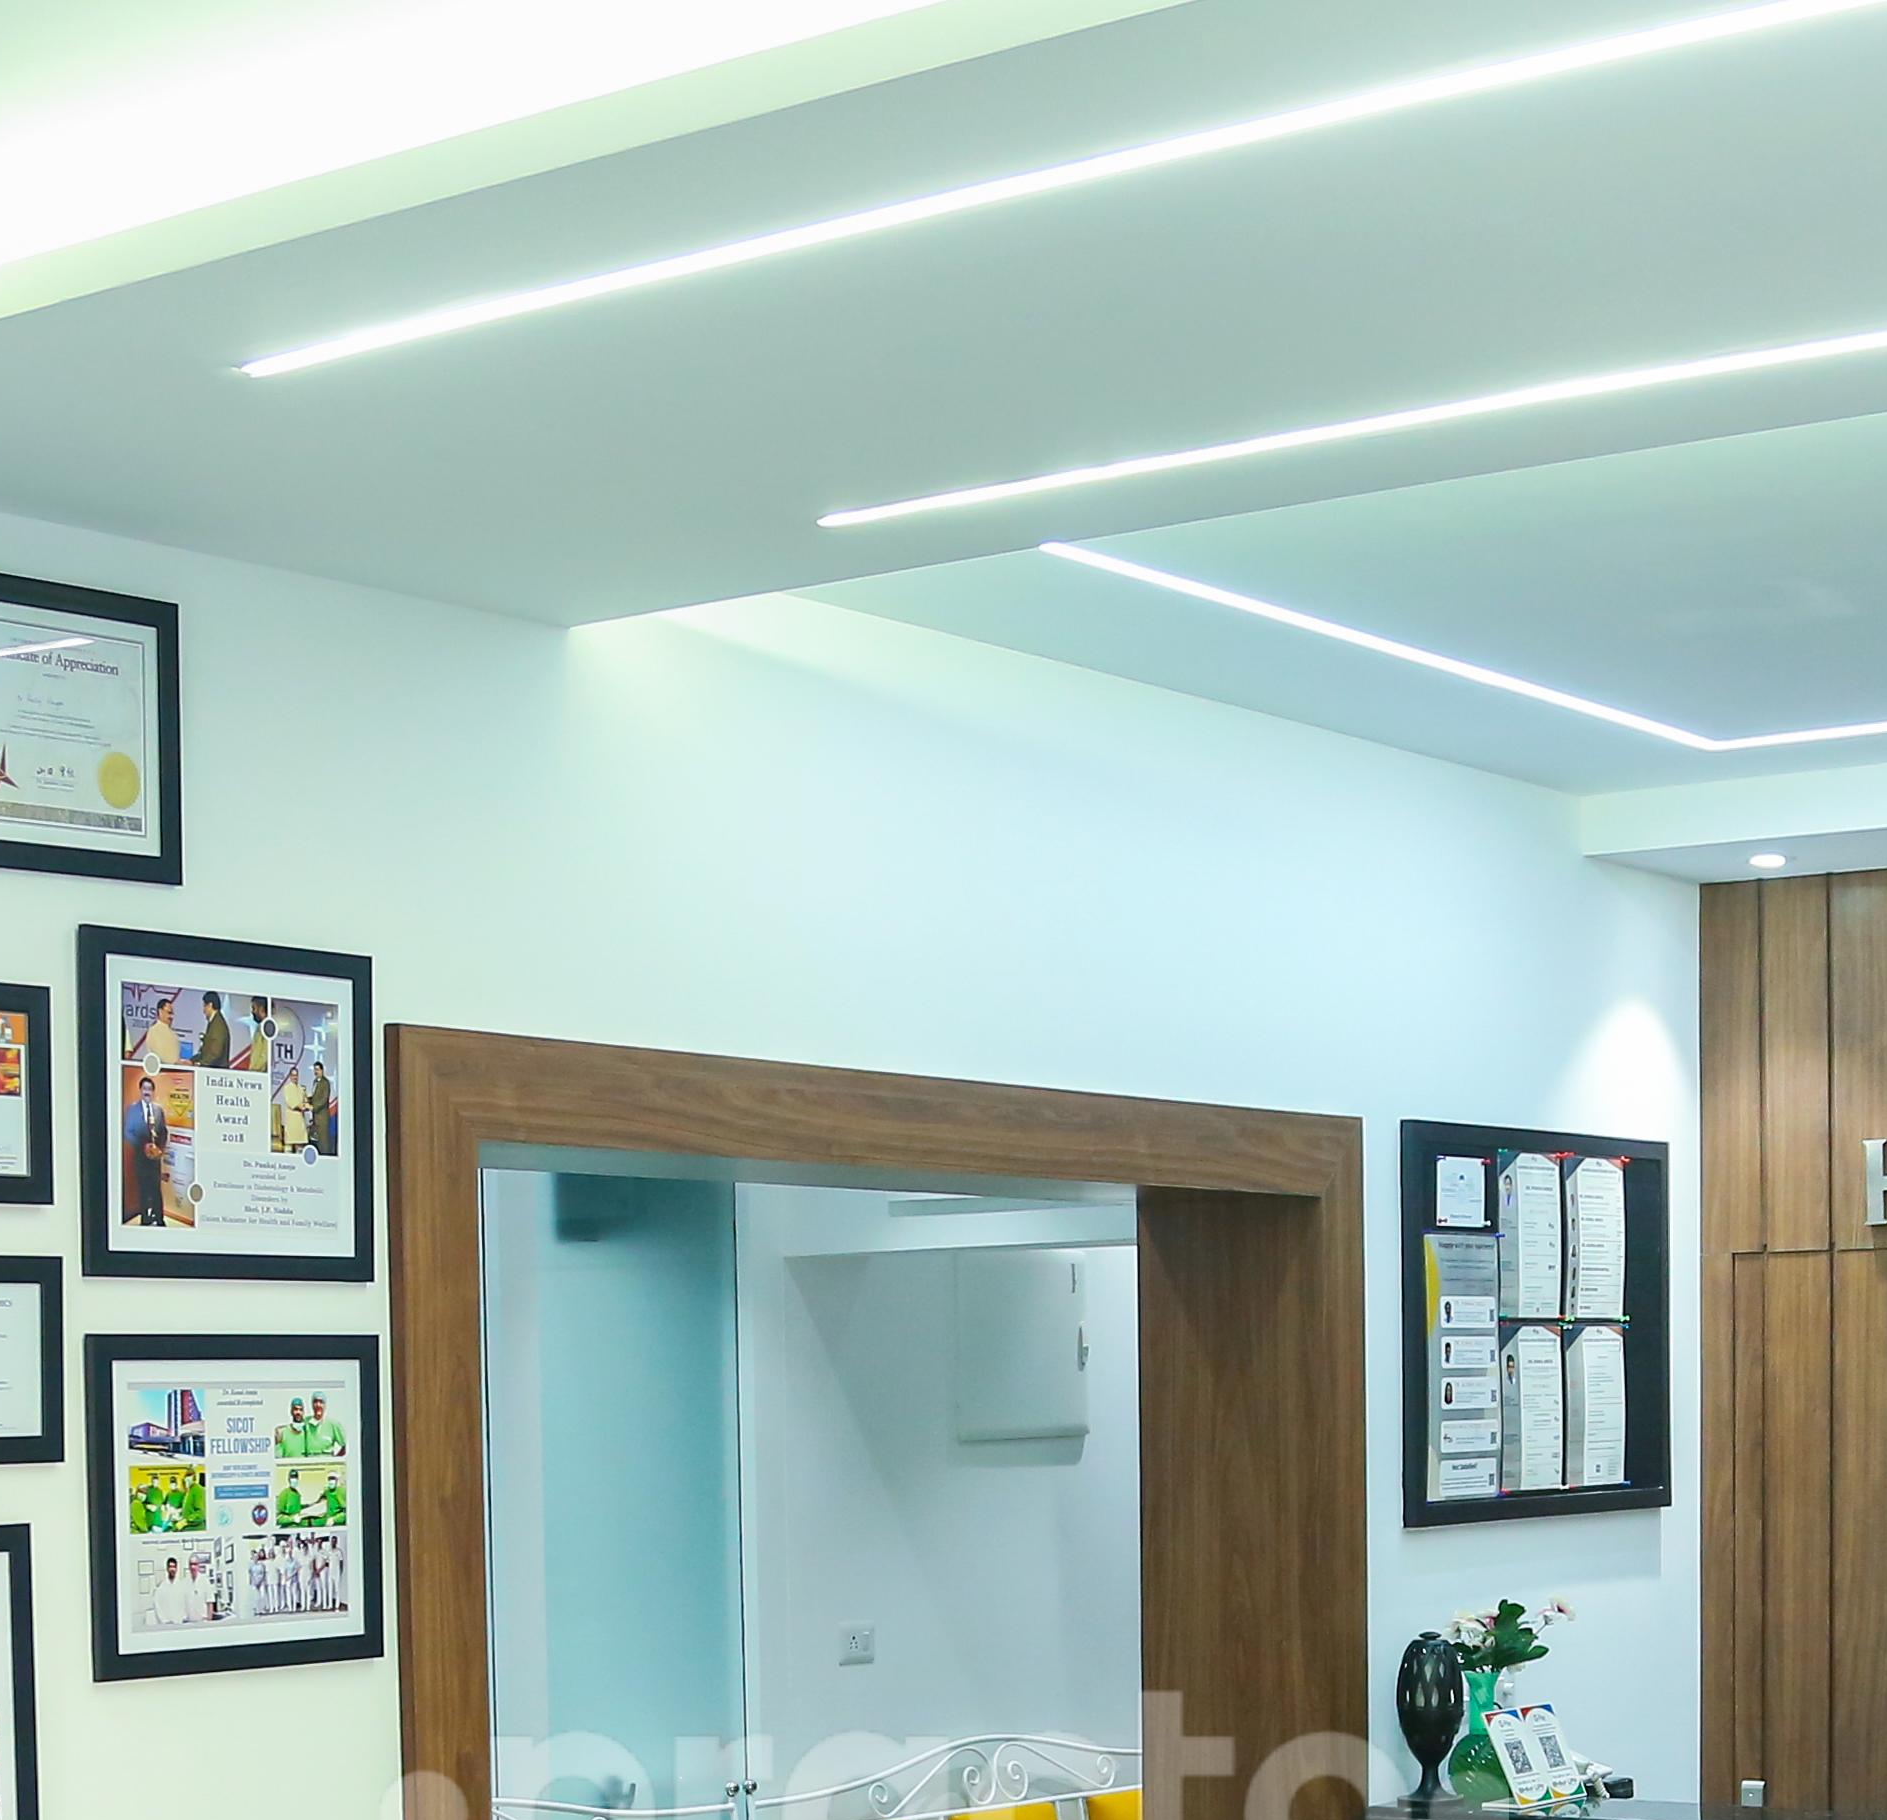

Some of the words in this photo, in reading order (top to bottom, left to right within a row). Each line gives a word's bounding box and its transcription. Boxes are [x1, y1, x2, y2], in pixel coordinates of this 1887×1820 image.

[206, 1076, 234, 1088] India
[236, 1079, 263, 1090] News
[216, 1095, 250, 1108] Health
[216, 1113, 248, 1125] Award
[226, 1417, 255, 1433] SICOT
[210, 1437, 271, 1454] FELLOWSHIP
